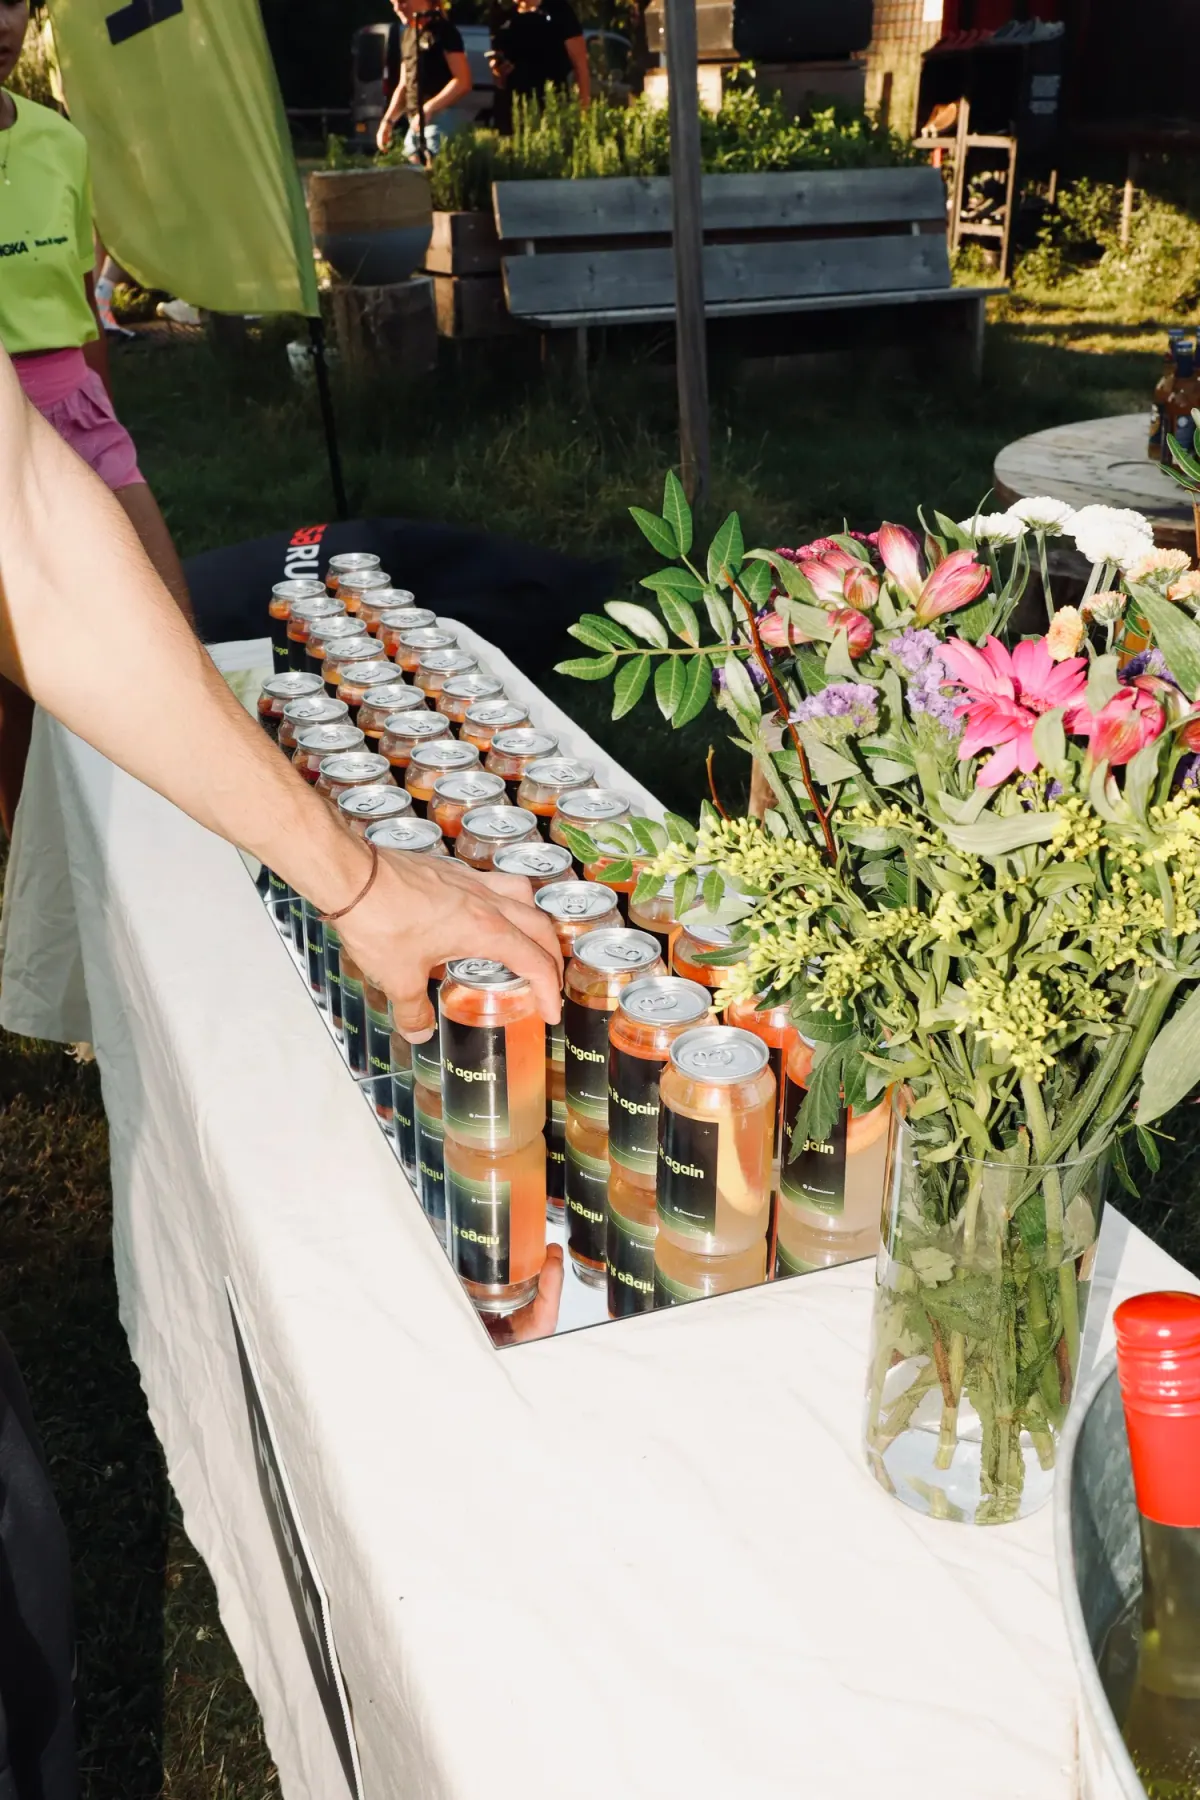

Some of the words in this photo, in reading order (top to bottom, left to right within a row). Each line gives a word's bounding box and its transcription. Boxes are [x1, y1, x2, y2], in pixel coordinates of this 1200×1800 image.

[571, 1045, 605, 1064] again
[455, 1067, 497, 1083] again
[620, 1098, 659, 1115] again
[803, 1139, 835, 1155] gain
[665, 1155, 705, 1180] again
